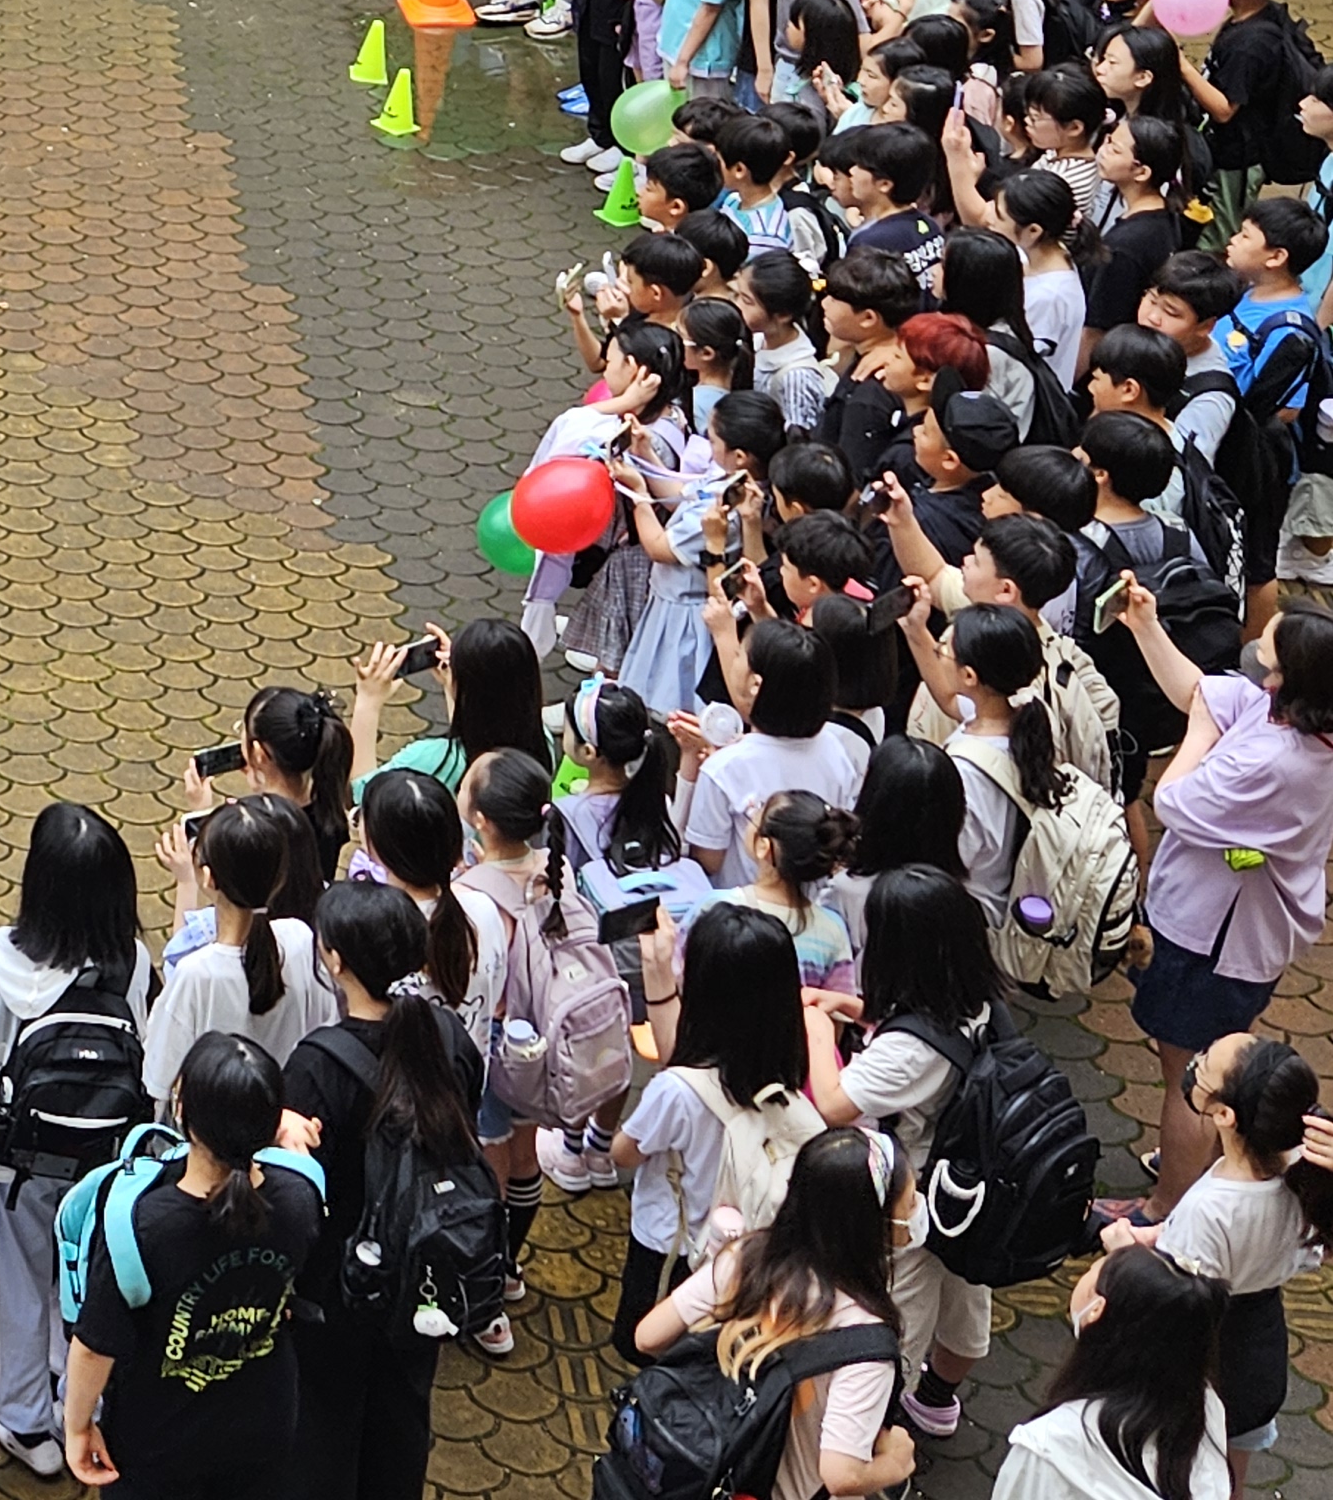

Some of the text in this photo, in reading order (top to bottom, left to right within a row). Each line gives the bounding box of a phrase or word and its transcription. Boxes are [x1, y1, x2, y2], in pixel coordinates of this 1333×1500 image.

[165, 1247, 290, 1361] COUNTRY LIFE FOR
